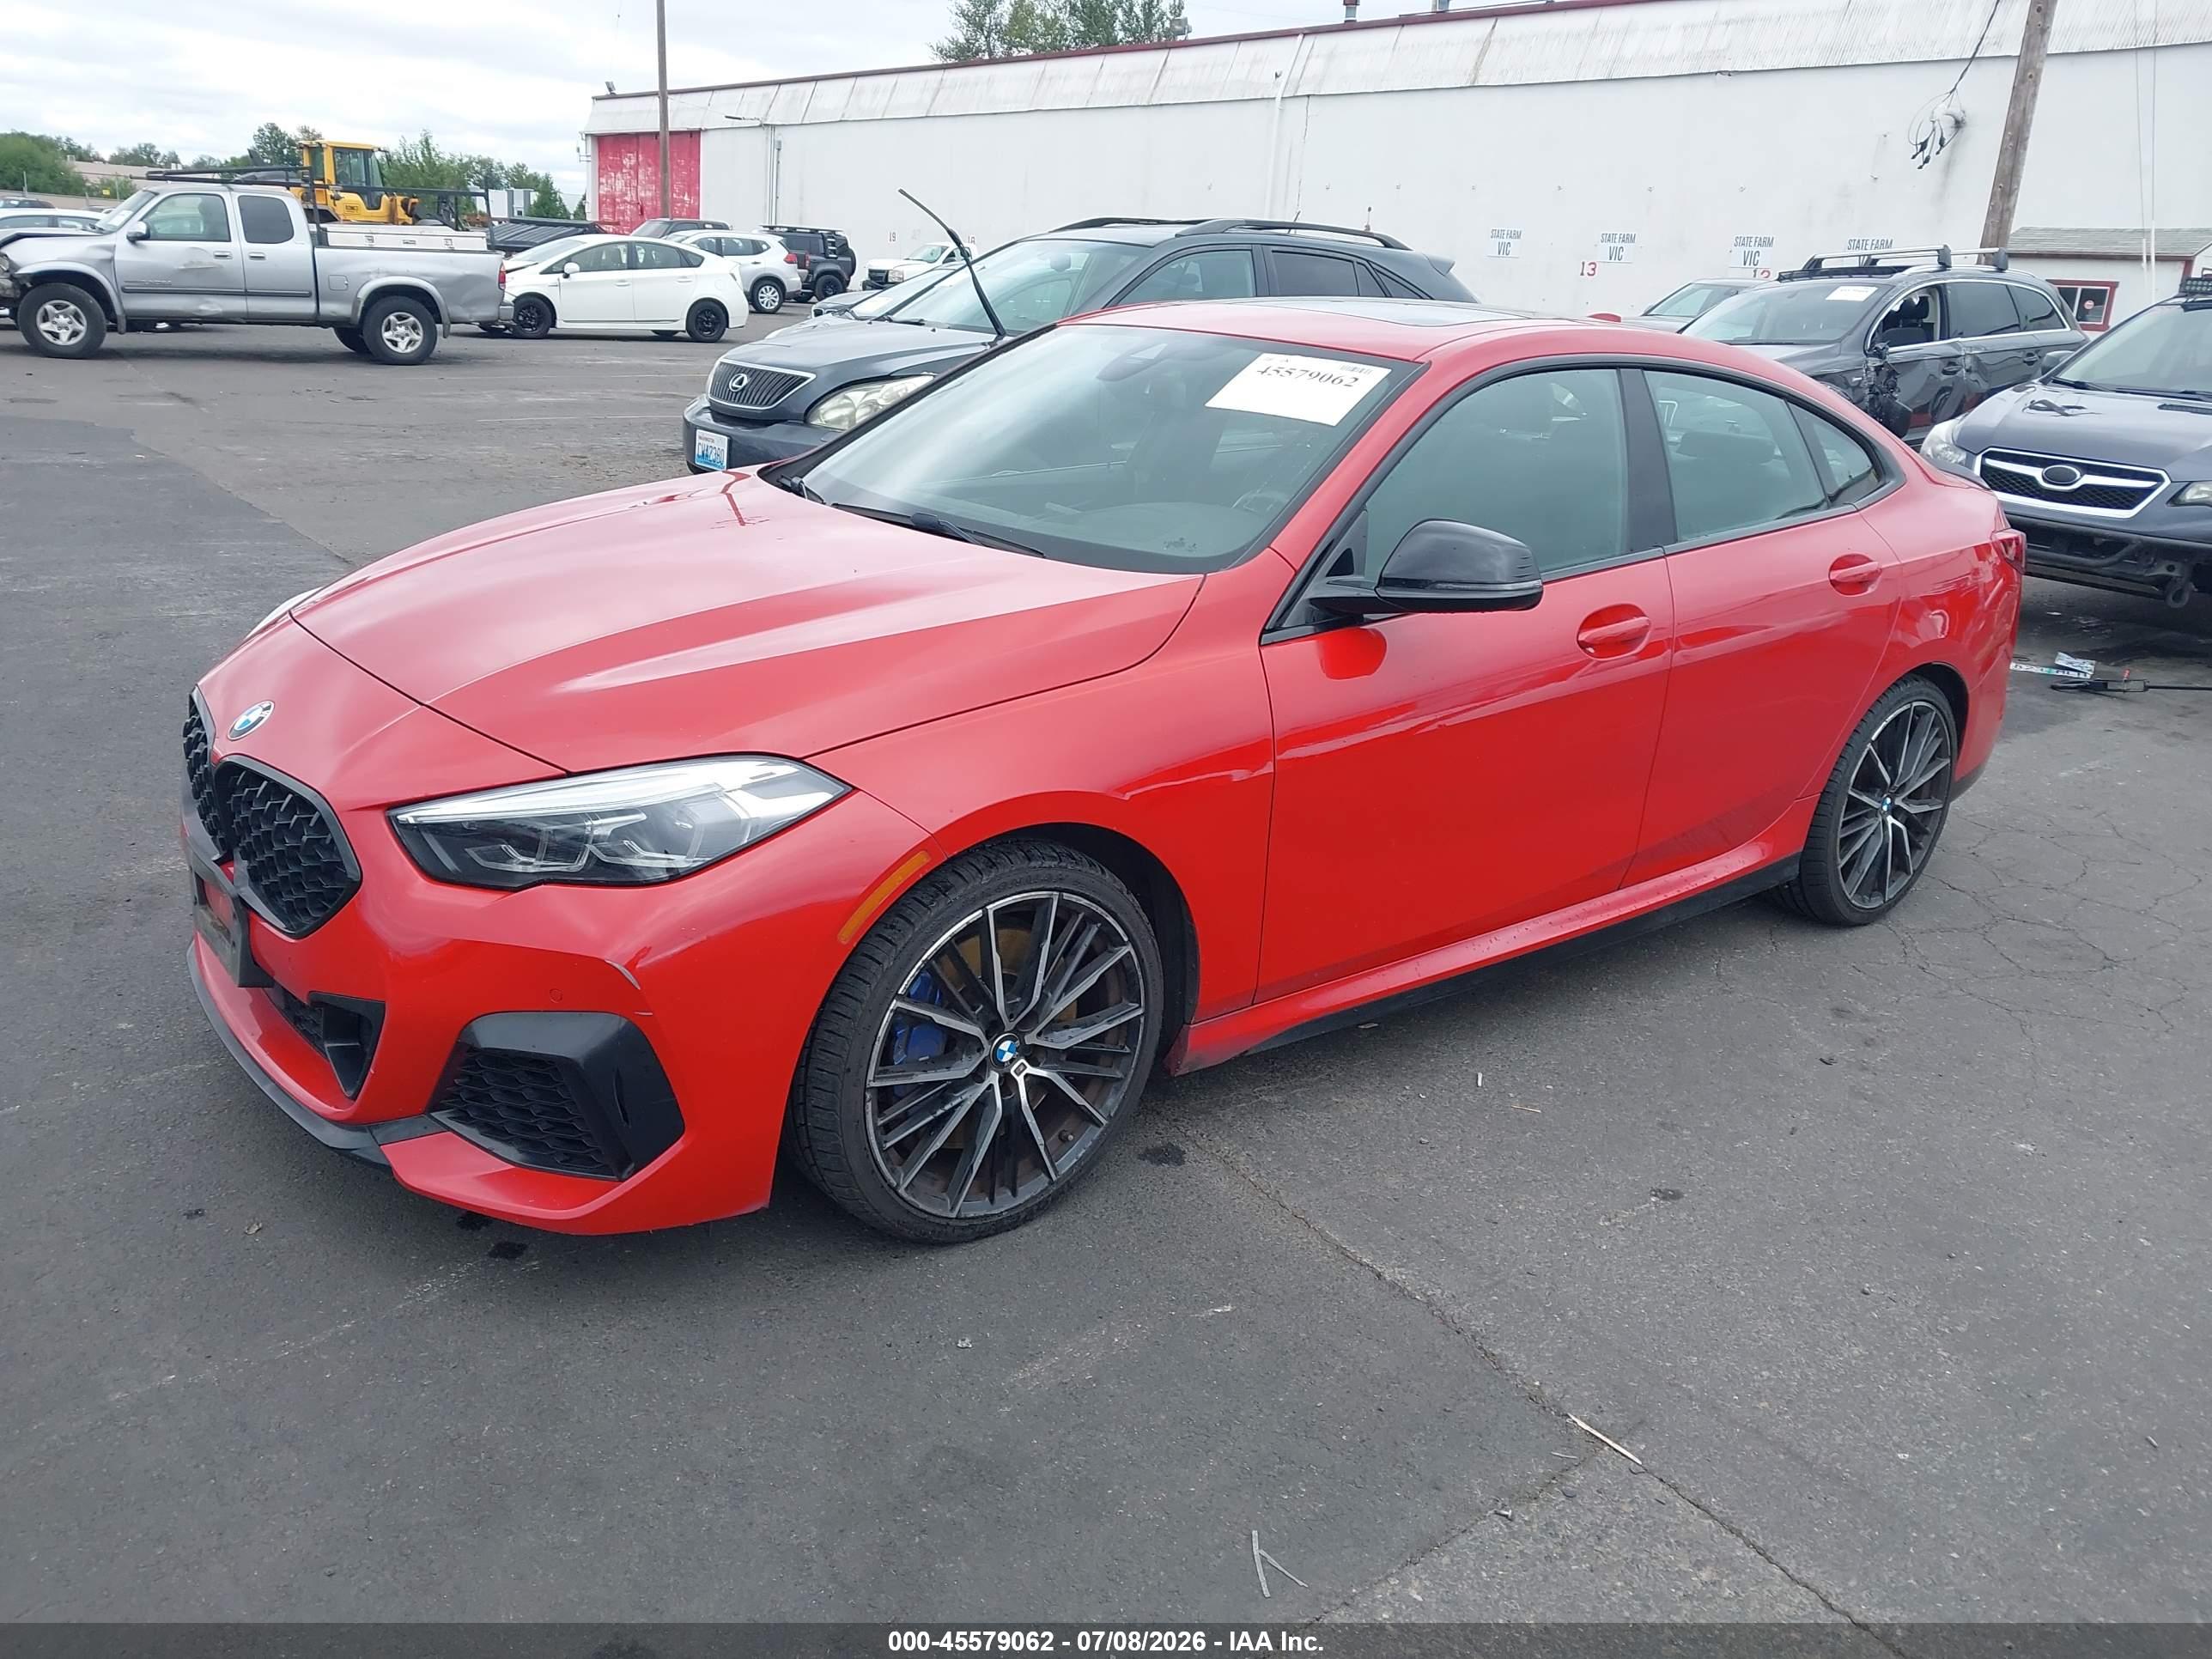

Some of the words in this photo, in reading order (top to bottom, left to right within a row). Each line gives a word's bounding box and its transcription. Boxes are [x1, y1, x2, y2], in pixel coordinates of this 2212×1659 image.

[1490, 228, 1505, 240] STATE
[1505, 229, 1522, 240] FARM
[1600, 233, 1618, 244] STATE
[1618, 234, 1636, 244] FARM
[1734, 235, 1753, 247] STATE
[1753, 236, 1774, 248] FARM
[1498, 241, 1511, 256] VIC
[1847, 239, 1870, 251] STATE
[1870, 239, 1893, 250] FARM
[1608, 246, 1625, 261] VIC
[1743, 250, 1760, 266] VIC
[1580, 261, 1597, 276] 13
[1256, 365, 1359, 387] 45579062
